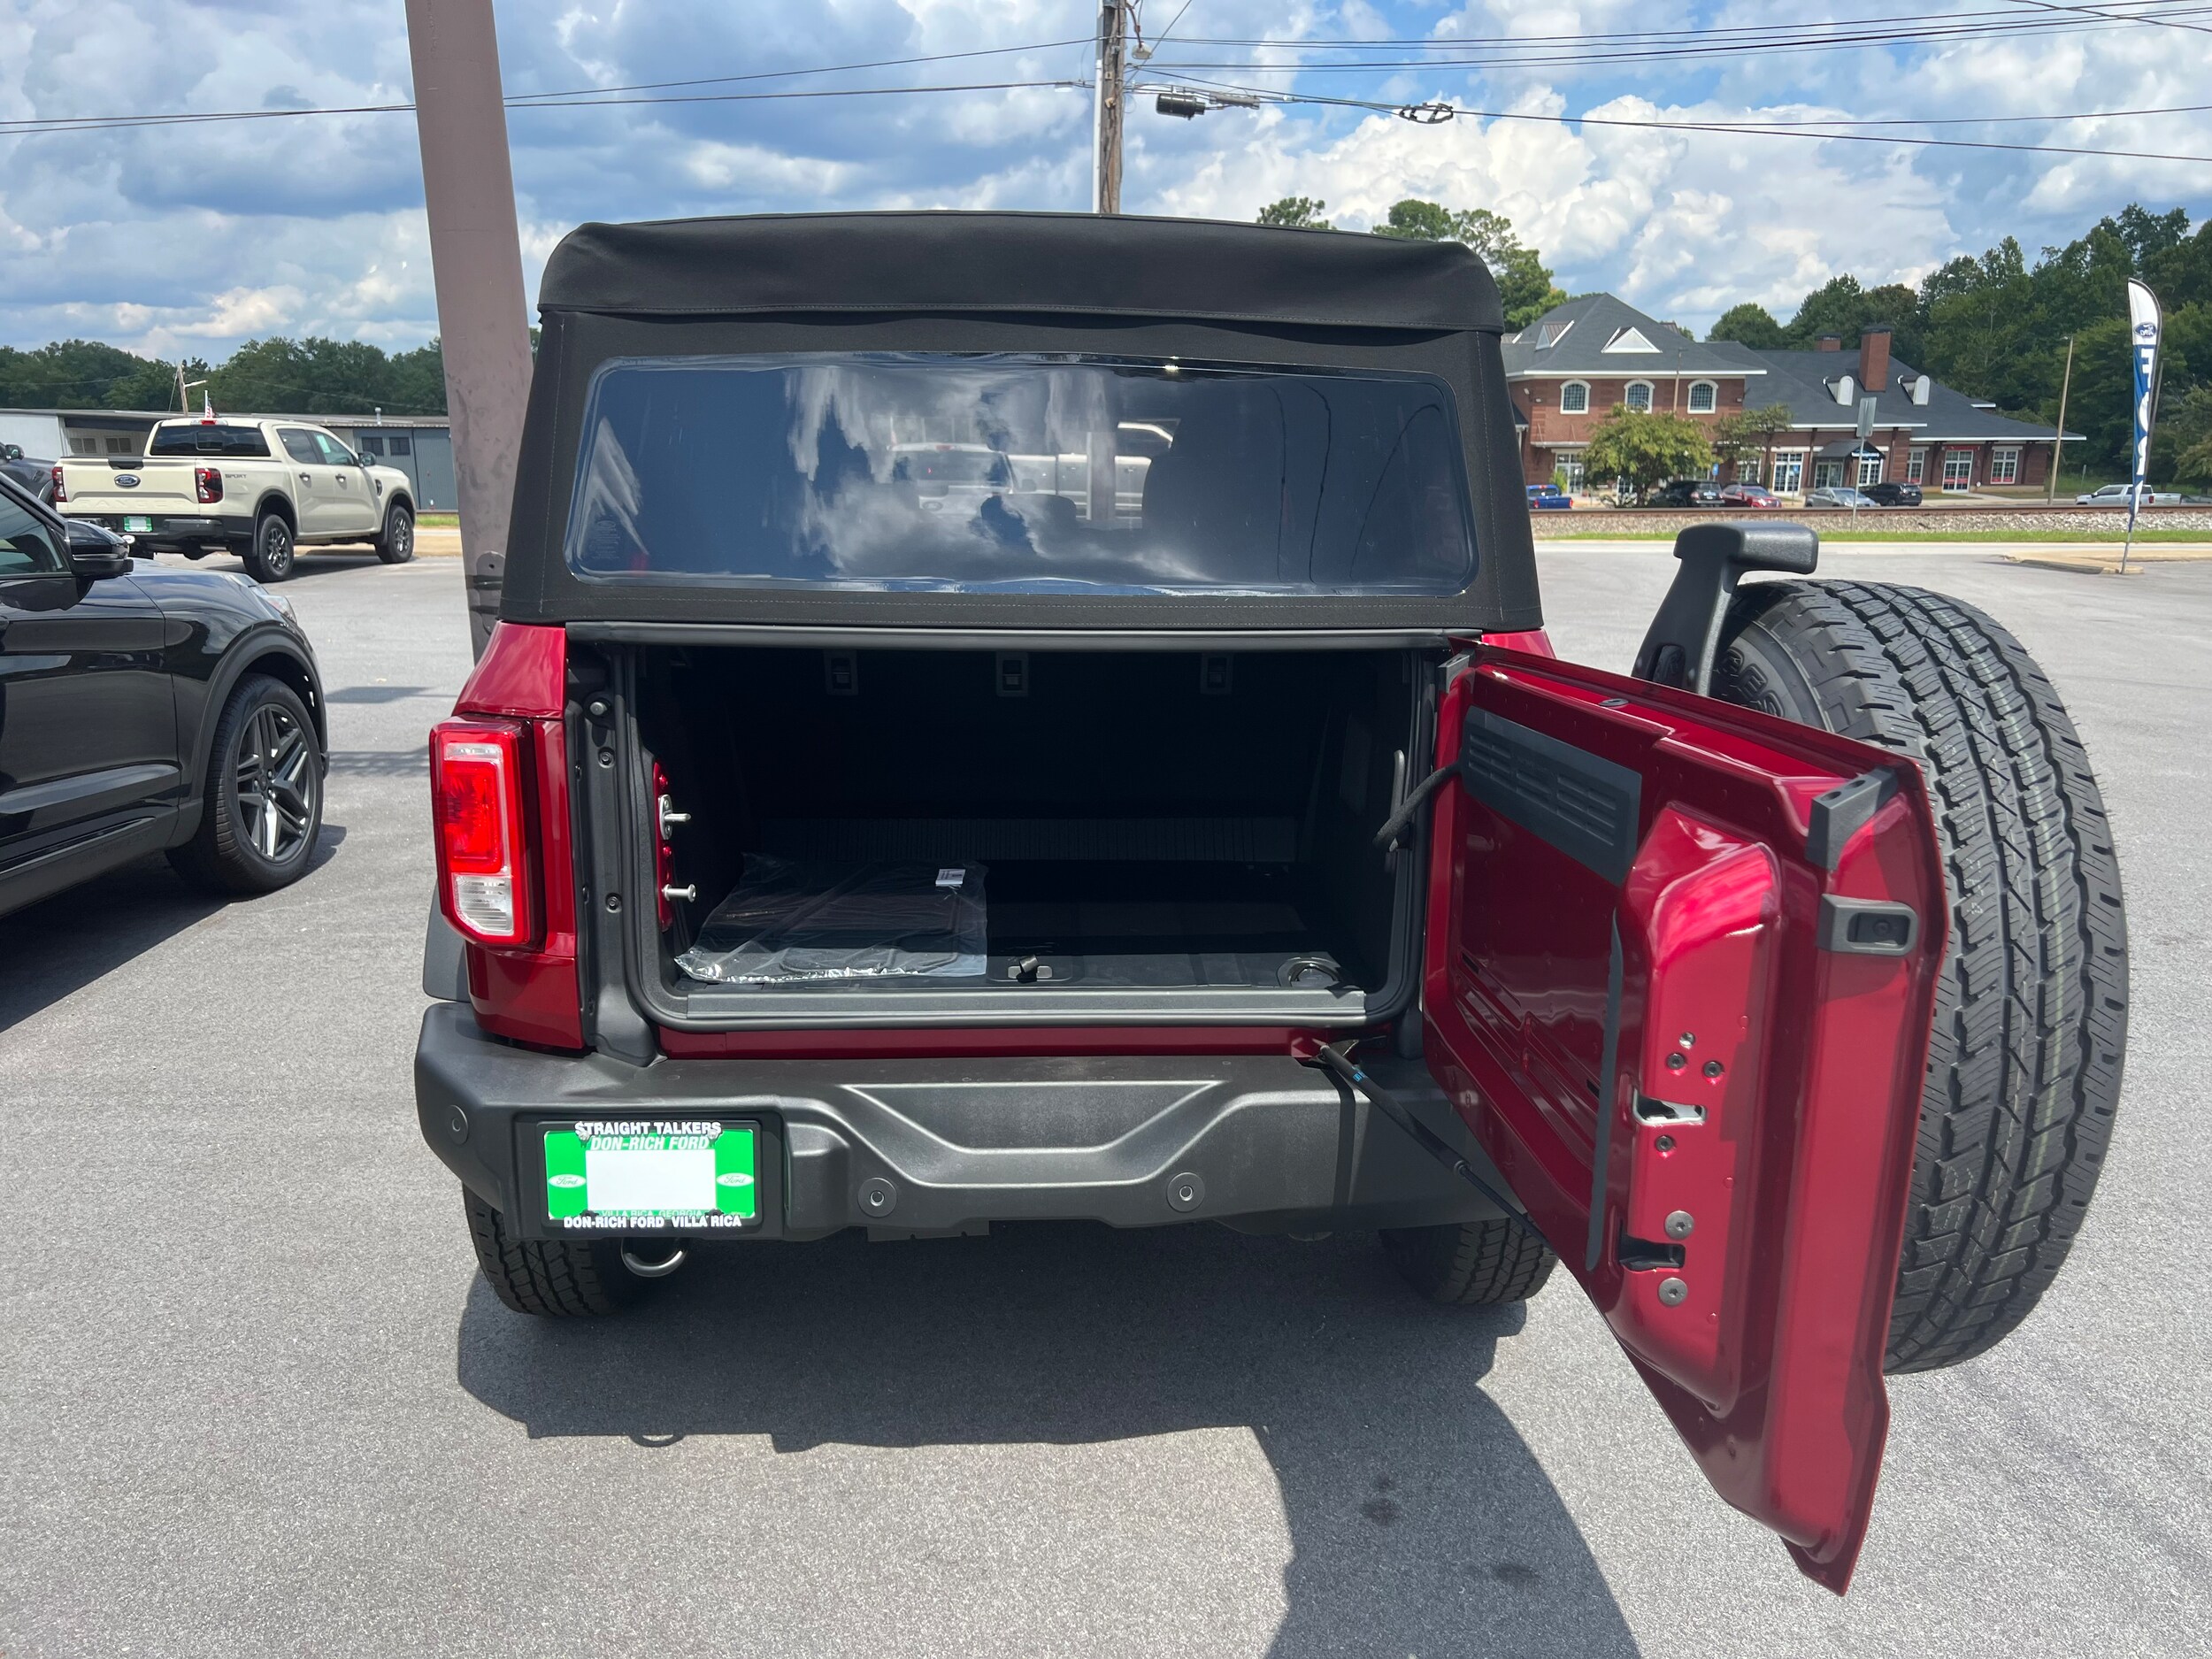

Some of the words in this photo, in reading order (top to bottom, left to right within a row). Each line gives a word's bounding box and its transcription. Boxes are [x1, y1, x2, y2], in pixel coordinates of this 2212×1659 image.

[78, 499, 187, 511] RANGER
[575, 1121, 650, 1135] STRAIGHT
[654, 1122, 722, 1135] TALKERS
[590, 1136, 664, 1150] DON-RICH
[668, 1135, 710, 1150] FORD
[564, 1216, 626, 1228] DON-RICH
[630, 1216, 664, 1228] FORD
[672, 1216, 708, 1227] VILLA
[710, 1215, 741, 1227] RICA
